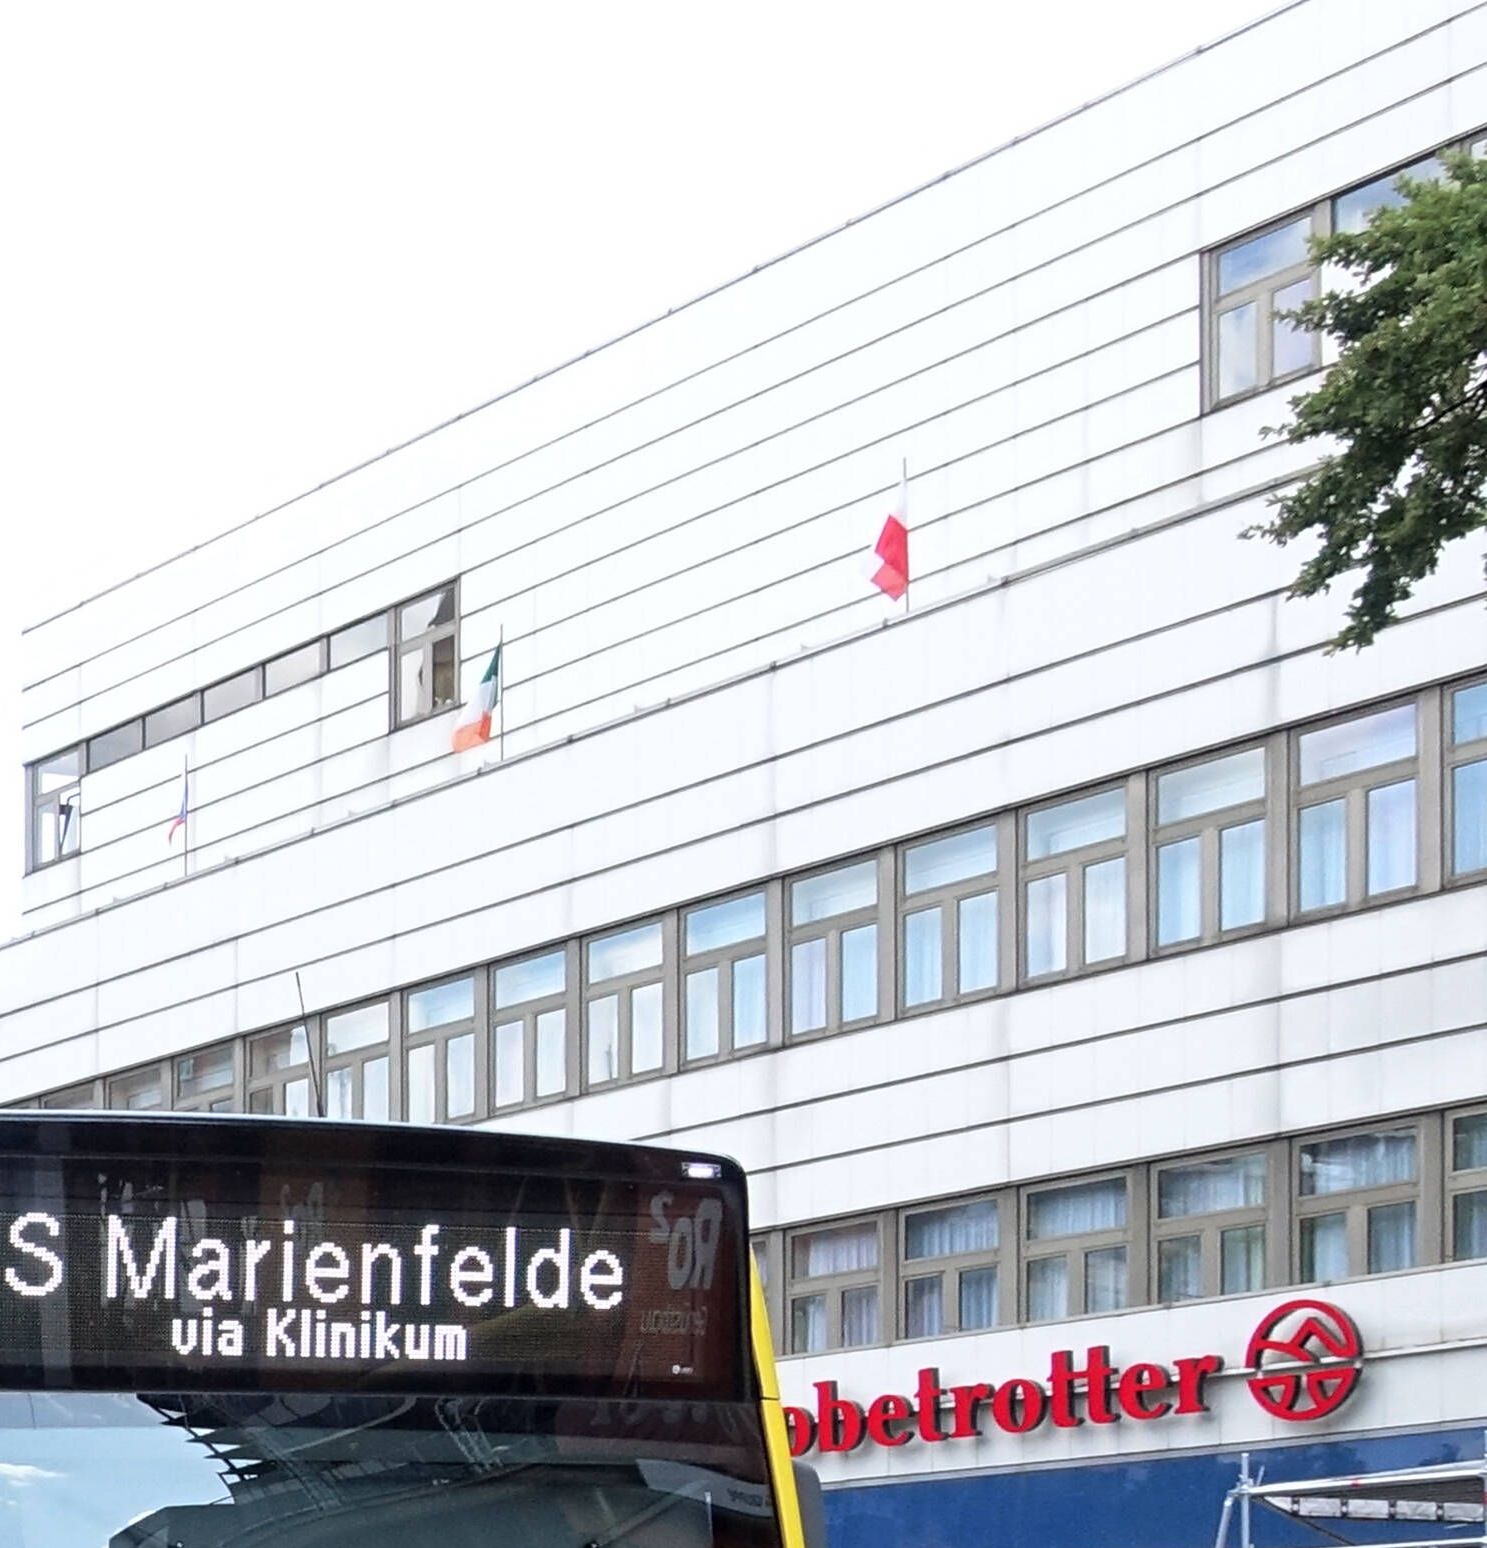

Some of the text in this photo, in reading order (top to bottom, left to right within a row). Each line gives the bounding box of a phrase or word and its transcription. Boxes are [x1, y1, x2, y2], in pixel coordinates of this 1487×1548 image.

[5, 1211, 60, 1296] S
[107, 1214, 625, 1310] Marienfelde
[171, 1307, 468, 1362] via Klinikum
